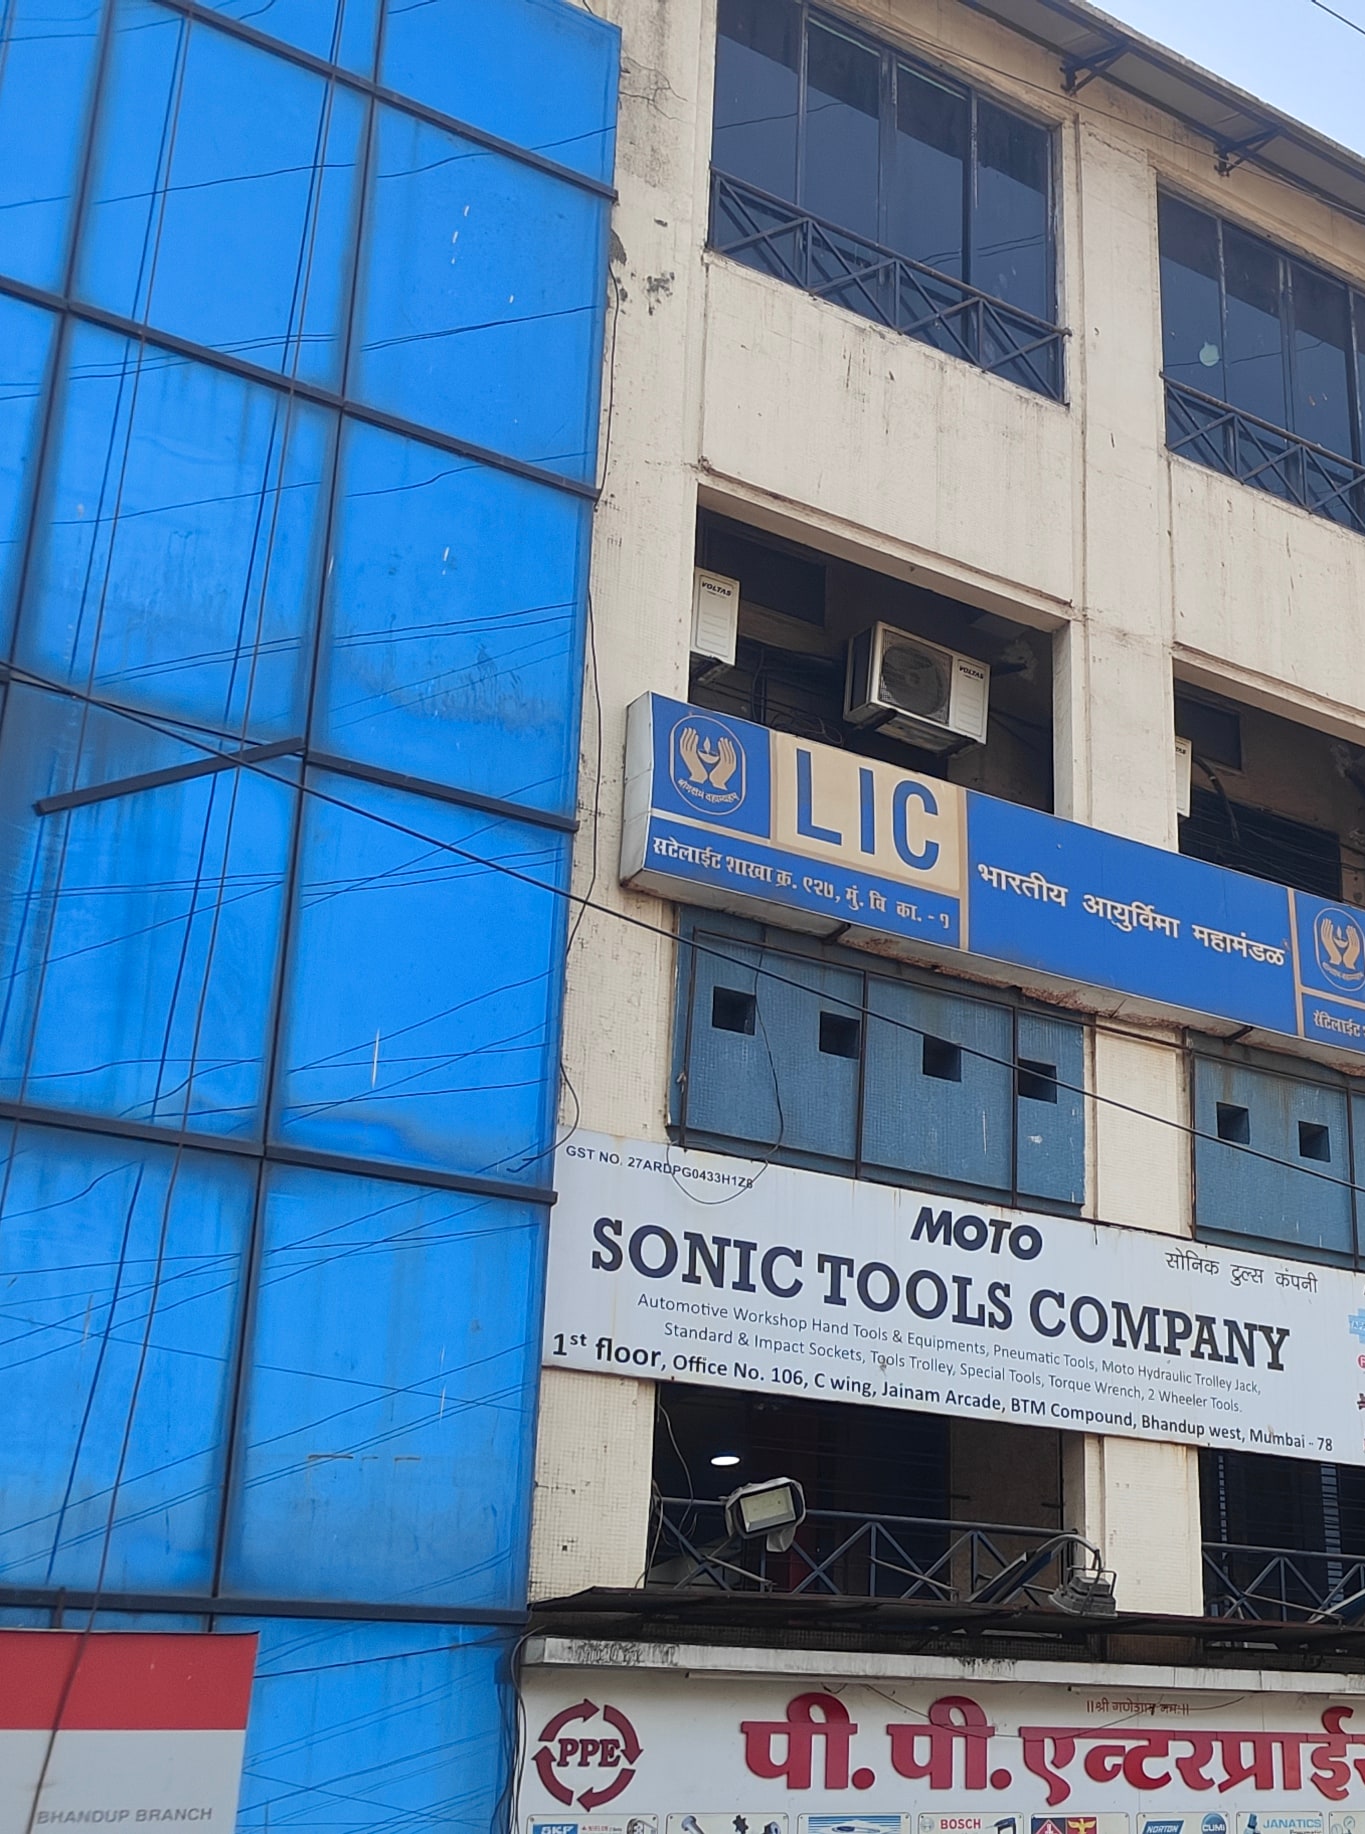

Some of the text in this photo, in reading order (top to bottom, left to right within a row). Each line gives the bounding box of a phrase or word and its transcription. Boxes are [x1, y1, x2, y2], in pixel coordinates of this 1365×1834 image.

[701, 580, 732, 597] VOLTAS
[958, 664, 984, 680] VOLTAS
[795, 746, 941, 873] LIC
[726, 857, 773, 883] शाखा
[977, 863, 1286, 967] भारतीय आयुर्विमा महामंडळ
[566, 1145, 595, 1160] GST
[599, 1151, 623, 1166] NO.
[911, 1206, 1043, 1261] MOTO
[1165, 1248, 1319, 1294] सोनिक टुल्स कंपनी
[591, 1216, 1290, 1372] SONIC TOOLS COMPANY
[637, 1293, 1261, 1396] Automotive Workshop Hand Tools & Equipments, Pneumatic Tools, Moto Hydraulic Trolley Jack,
[664, 1321, 1243, 1413] Standard & Impact Sockets, Tools Trolley, Special Tools, Torque Wrench, 2 Wheeler Tools.
[553, 1330, 1334, 1451] 1st floor, Office No. 106, C wing, Jainam Arcade, BTM Compound, Bhandup west, Mumbai 78
[556, 1737, 621, 1769] PPE
[36, 1807, 213, 1825] BHANDUP BRANCH
[940, 1818, 982, 1830] BOSCH
[1146, 1823, 1180, 1834] NORTON
[1263, 1818, 1322, 1829] JANATICS
